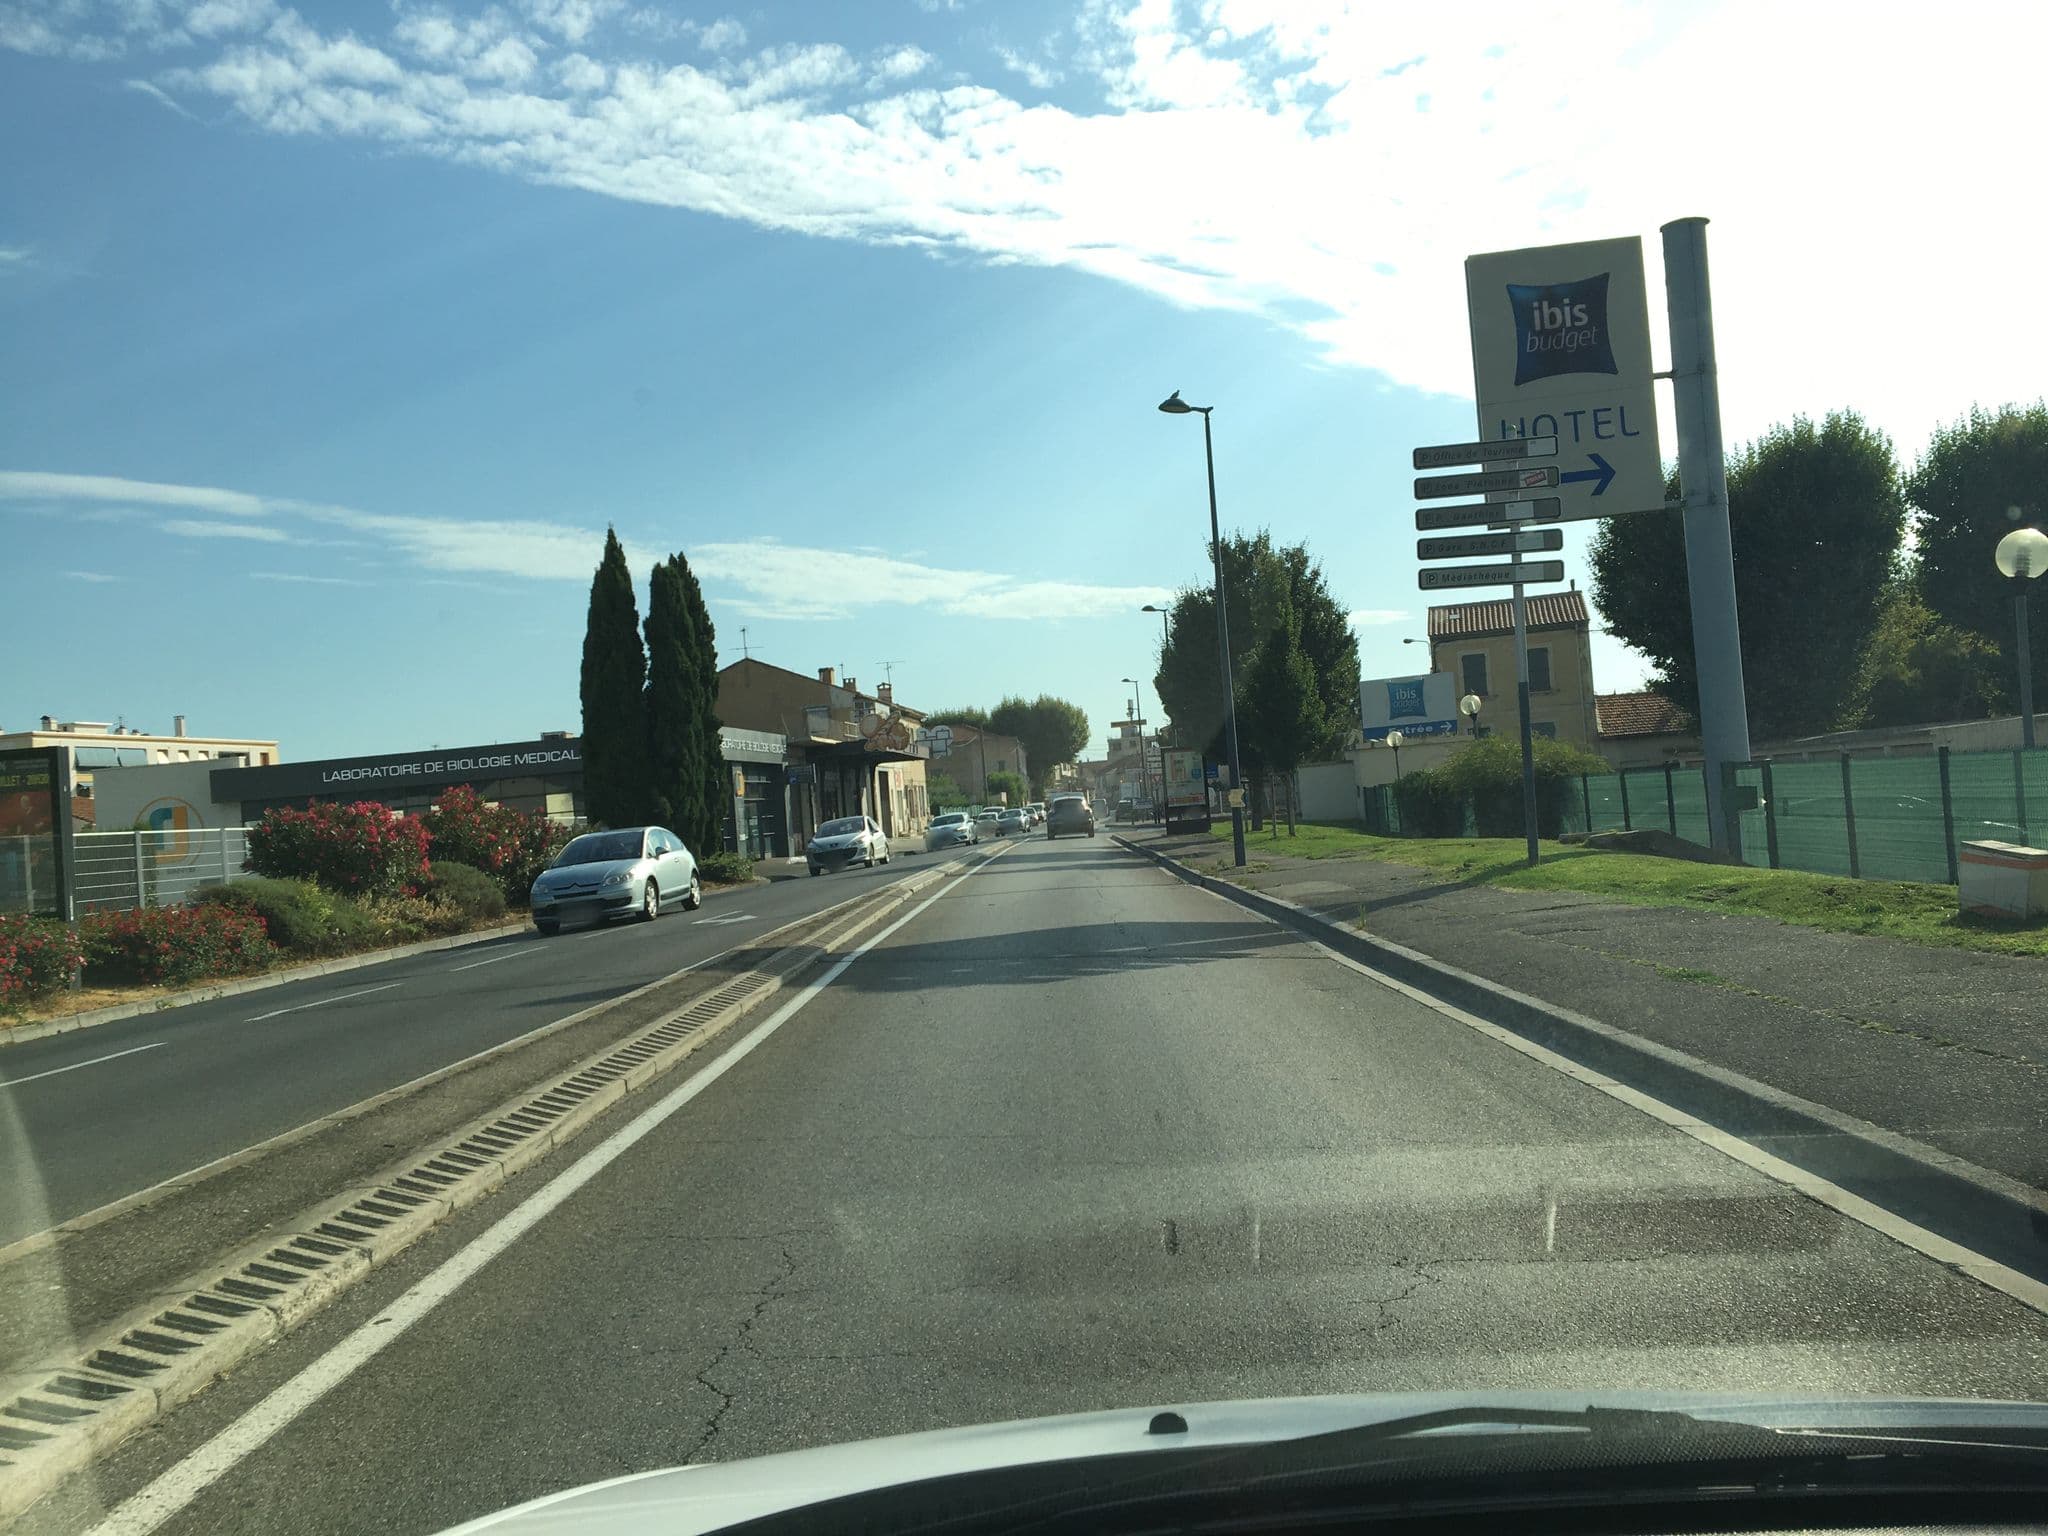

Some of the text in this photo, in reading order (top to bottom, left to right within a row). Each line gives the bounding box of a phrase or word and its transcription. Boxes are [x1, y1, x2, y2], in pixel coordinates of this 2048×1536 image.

[1532, 297, 1589, 331] ibis
[1526, 326, 1599, 353] budget
[1500, 405, 1640, 443] HOTEL
[1396, 688, 1417, 700] ibis
[322, 749, 582, 783] LABORATOIRE DE BIOLOGIE MEDICAL
